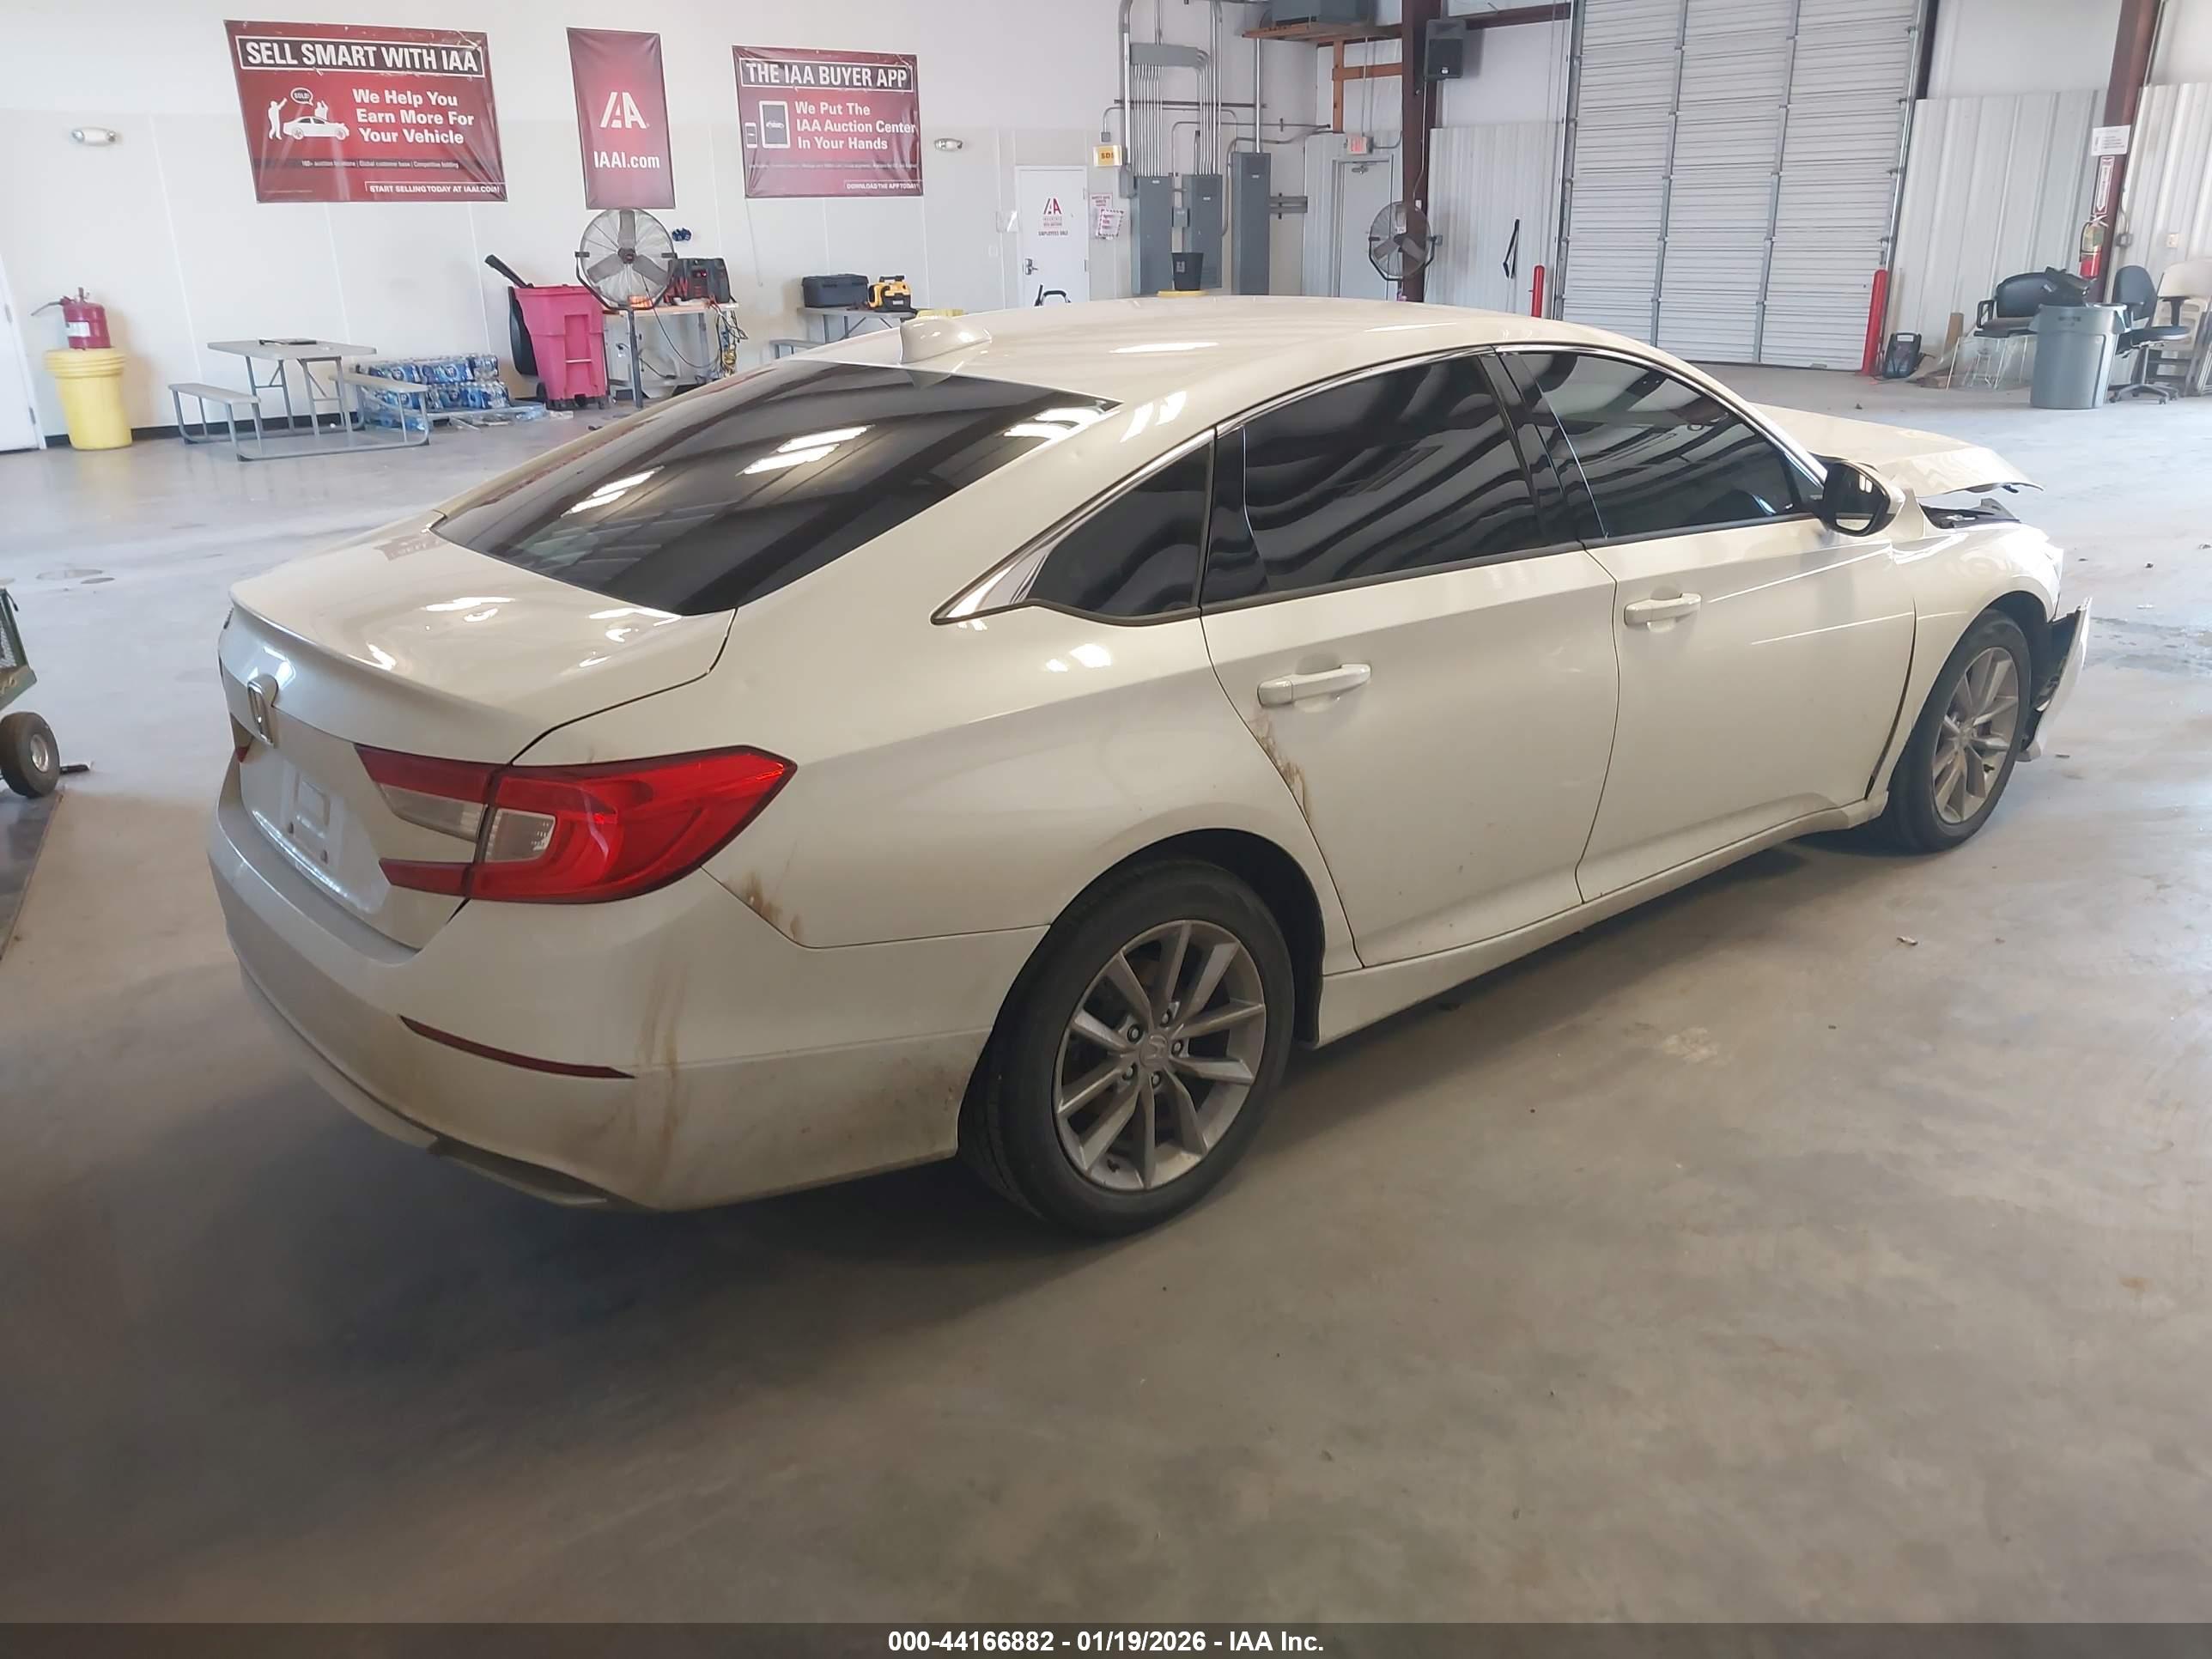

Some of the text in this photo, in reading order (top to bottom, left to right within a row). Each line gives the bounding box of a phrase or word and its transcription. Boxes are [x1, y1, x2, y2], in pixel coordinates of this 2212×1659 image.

[246, 41, 478, 72] SELL SMART WITH IAA
[746, 63, 907, 88] THE IAA BUYER APP
[352, 88, 458, 108] We Help You
[356, 108, 474, 125] Earn More For
[795, 100, 871, 116] We Put The
[796, 118, 916, 133] IAA Auction Center
[358, 127, 464, 144] Your Vehicle
[798, 136, 888, 149] In Your Hands
[593, 150, 659, 168] IAAI.com
[369, 185, 393, 193] START
[395, 185, 427, 193] SELLING
[427, 185, 451, 193] TODAY
[453, 185, 462, 193] AT
